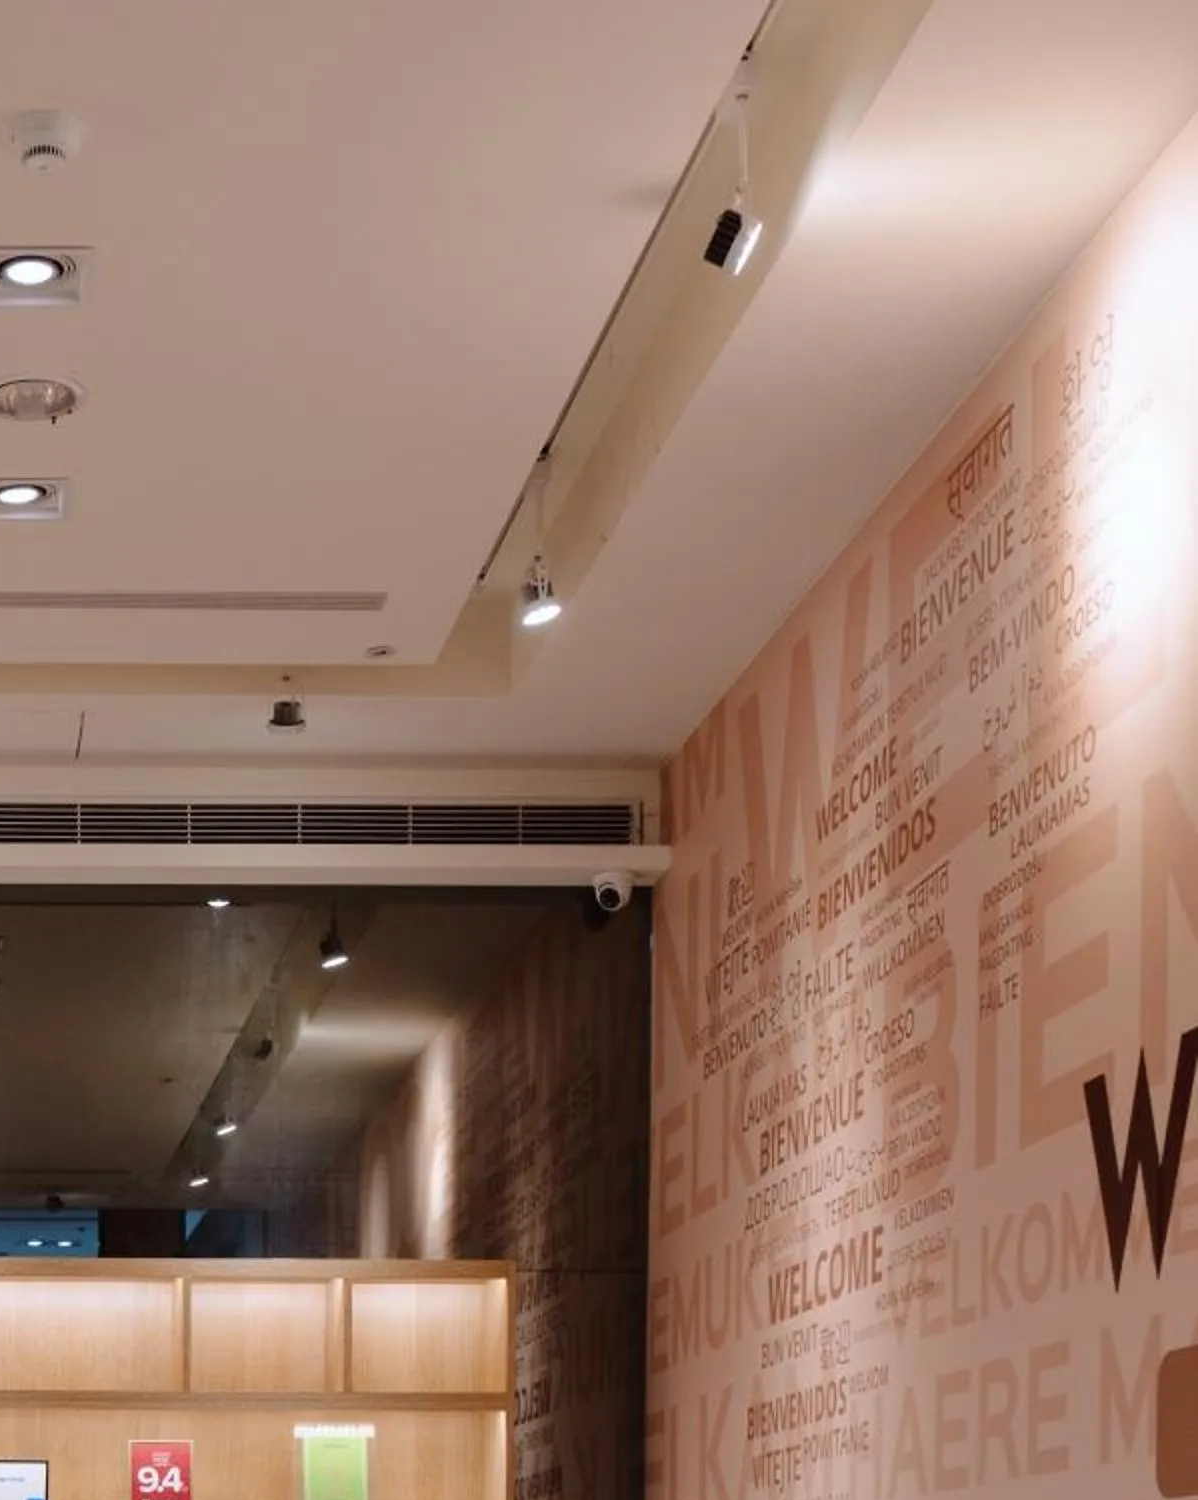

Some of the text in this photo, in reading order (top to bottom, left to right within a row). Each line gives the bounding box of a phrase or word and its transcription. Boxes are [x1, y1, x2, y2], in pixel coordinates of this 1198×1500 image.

[900, 504, 1014, 667] BIENVENUE
[968, 558, 1075, 695] BEM-VINDO
[1054, 573, 1115, 659] CROESO
[815, 734, 896, 848] WELCOME
[988, 717, 1098, 843] BENVENUTO
[817, 791, 937, 932] BIENVENIDOS
[862, 904, 945, 998] WILLKOMMEN
[864, 1004, 915, 1067] CROESO
[759, 1068, 864, 1176] BIENVENUE
[767, 1223, 883, 1327] WELCOME
[747, 1373, 847, 1441] BIENVENIDOS
[803, 1419, 870, 1464] POWITANIE
[137, 1466, 184, 1493] 9.4
